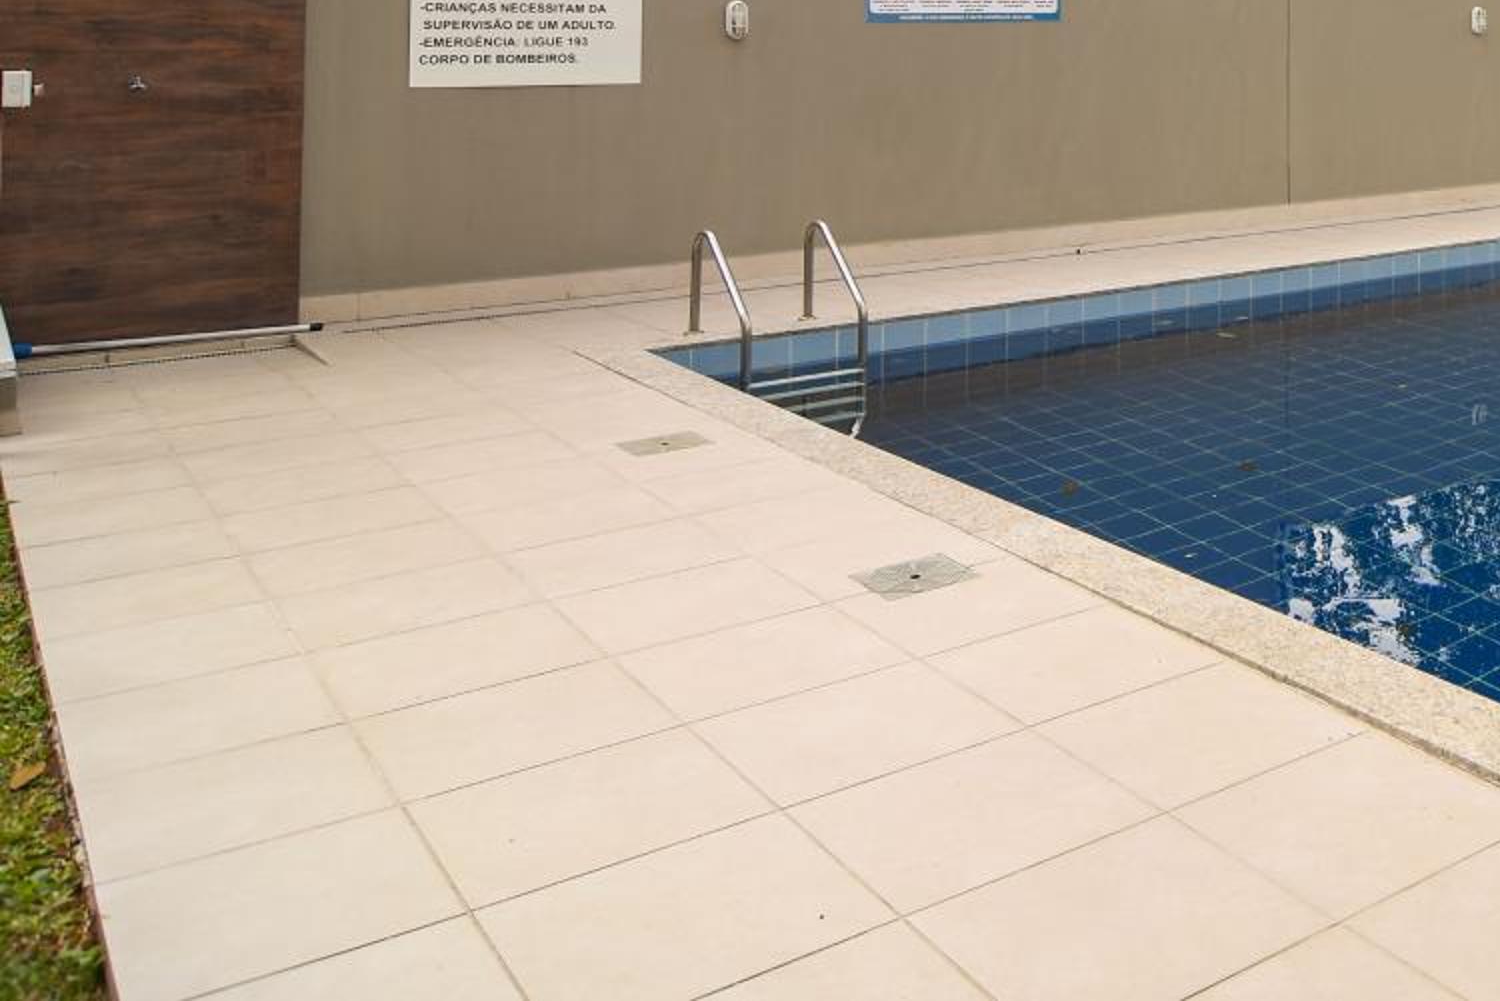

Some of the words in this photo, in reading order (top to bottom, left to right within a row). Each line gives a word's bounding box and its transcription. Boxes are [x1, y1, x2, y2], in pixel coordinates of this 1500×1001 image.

[501, 3, 584, 14] NECESSITAM
[589, 4, 606, 14] DA
[424, 18, 512, 30] SUPERVISÃO
[516, 20, 534, 30] DE
[538, 20, 558, 30] UM
[524, 36, 563, 47] LIGUE
[566, 36, 588, 47] 193
[419, 54, 469, 66] CORPO
[474, 54, 492, 64] DE
